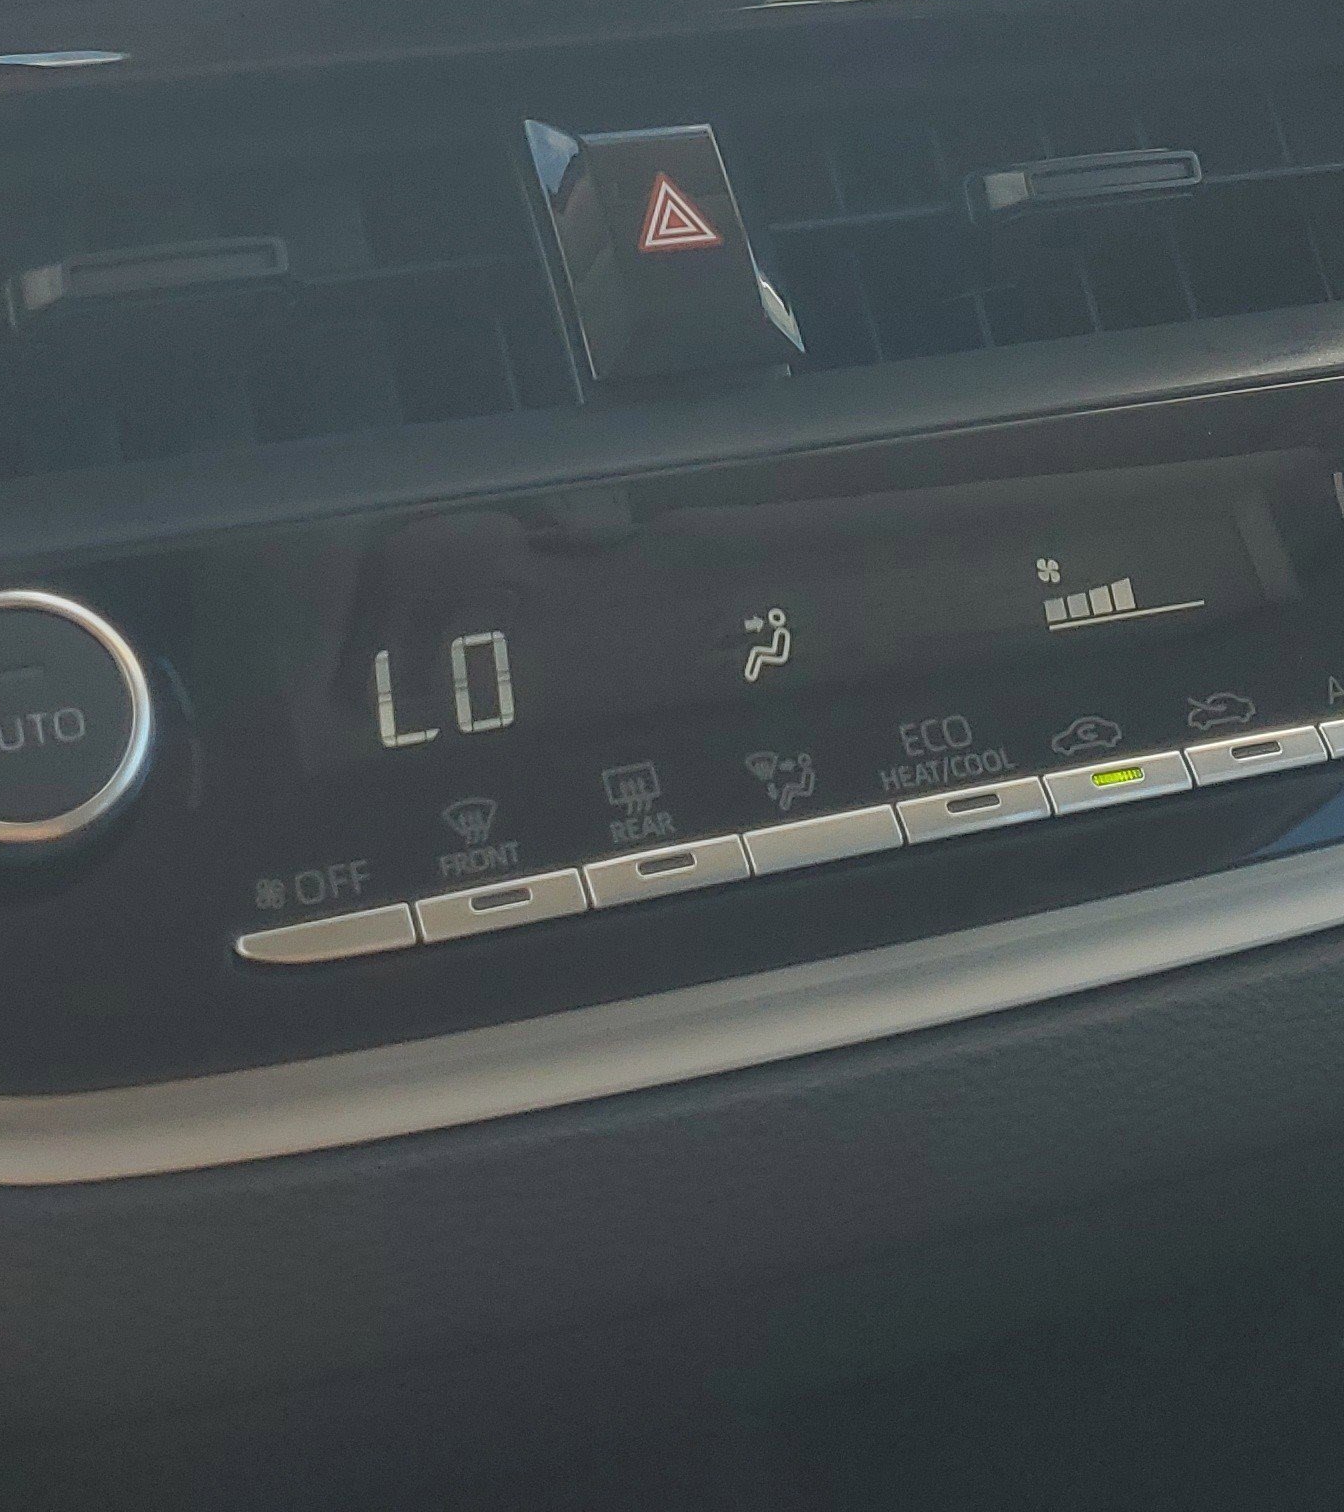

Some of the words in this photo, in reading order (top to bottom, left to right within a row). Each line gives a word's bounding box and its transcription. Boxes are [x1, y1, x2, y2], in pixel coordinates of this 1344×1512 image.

[374, 630, 515, 748] LO
[900, 715, 975, 758] ECO
[881, 749, 1016, 793] HEAT/COOL
[609, 811, 675, 844] REAR
[439, 840, 520, 878] FRONT
[294, 858, 370, 906] OFF
